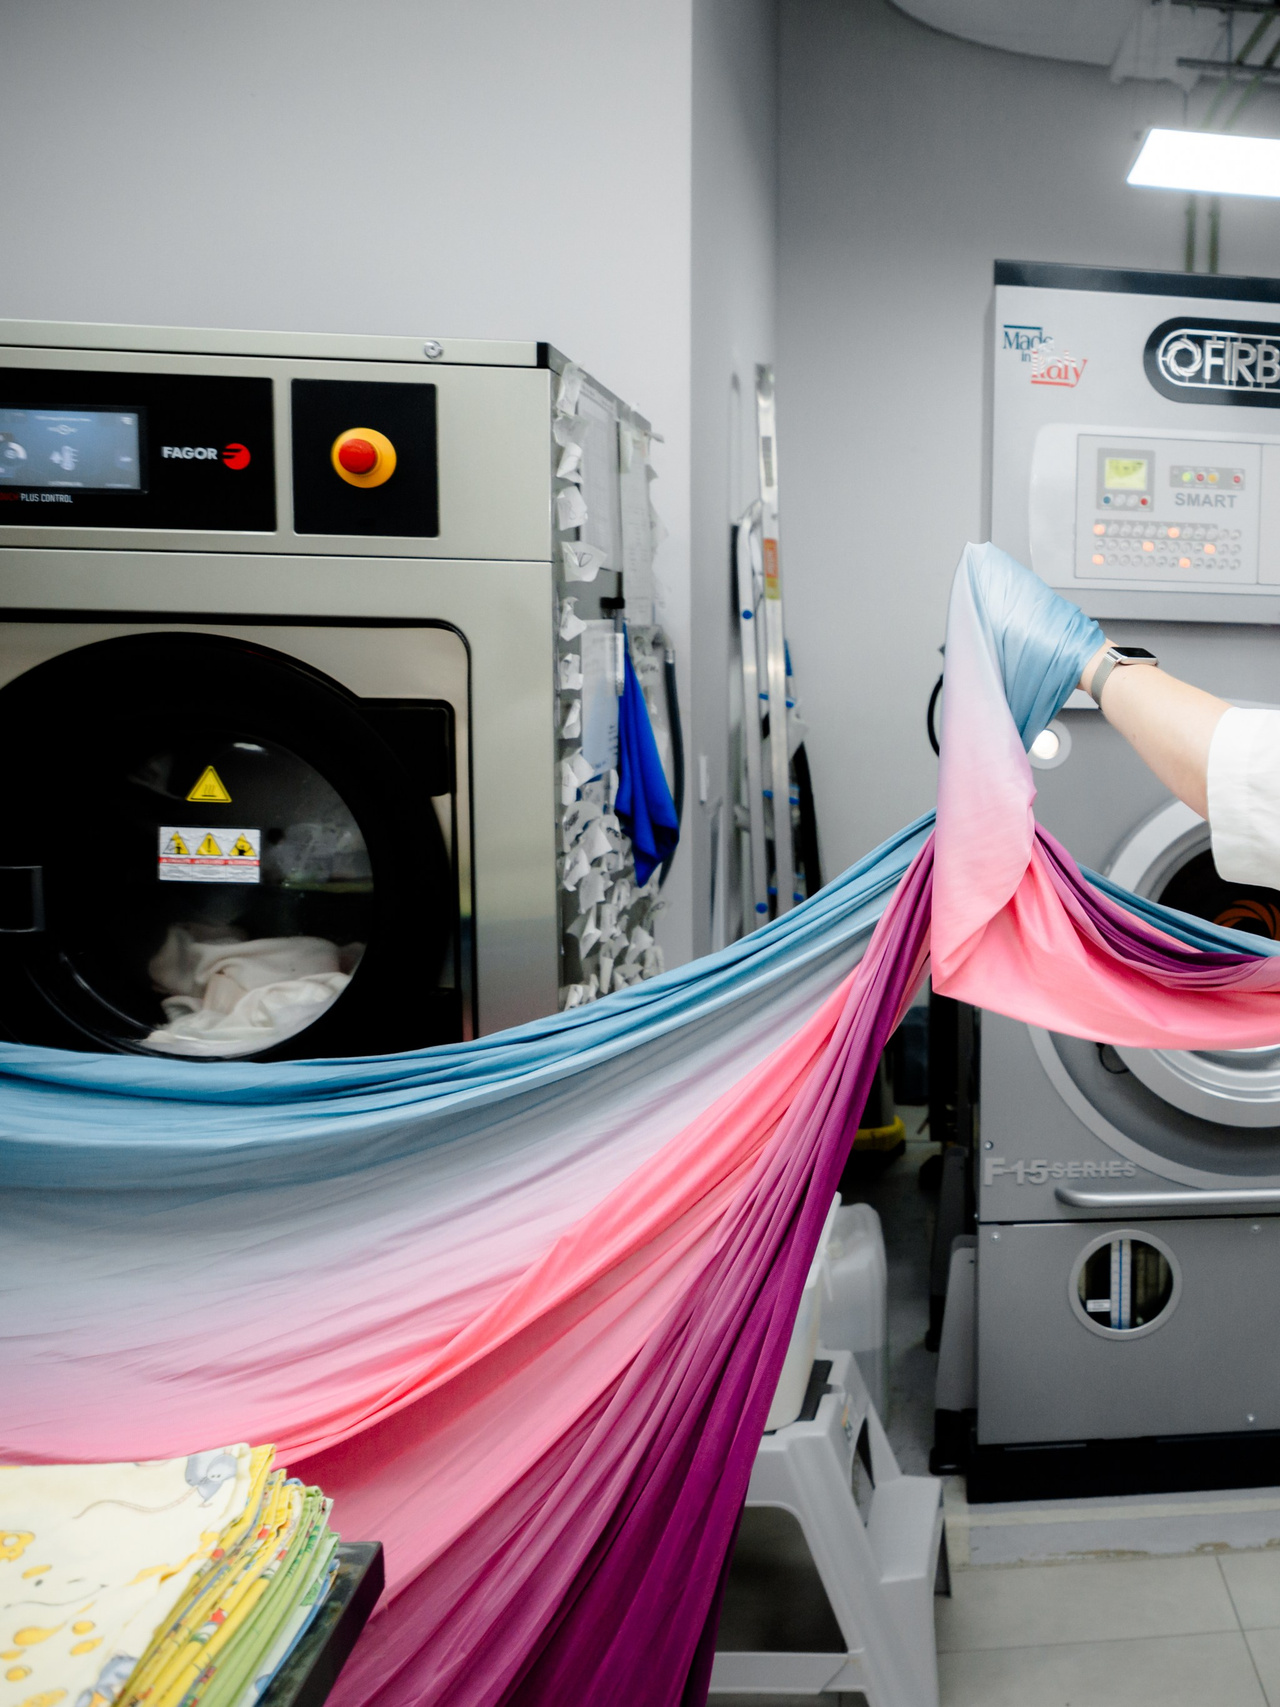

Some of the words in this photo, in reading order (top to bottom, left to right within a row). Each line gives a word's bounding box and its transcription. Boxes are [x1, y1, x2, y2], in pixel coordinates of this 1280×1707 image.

[1003, 330, 1054, 350] Made
[161, 446, 218, 460] FAGOR
[20, 492, 40, 503] PLUS
[41, 493, 74, 504] CONTROL
[1174, 492, 1237, 509] SMART
[1051, 1160, 1138, 1179] SERIES
